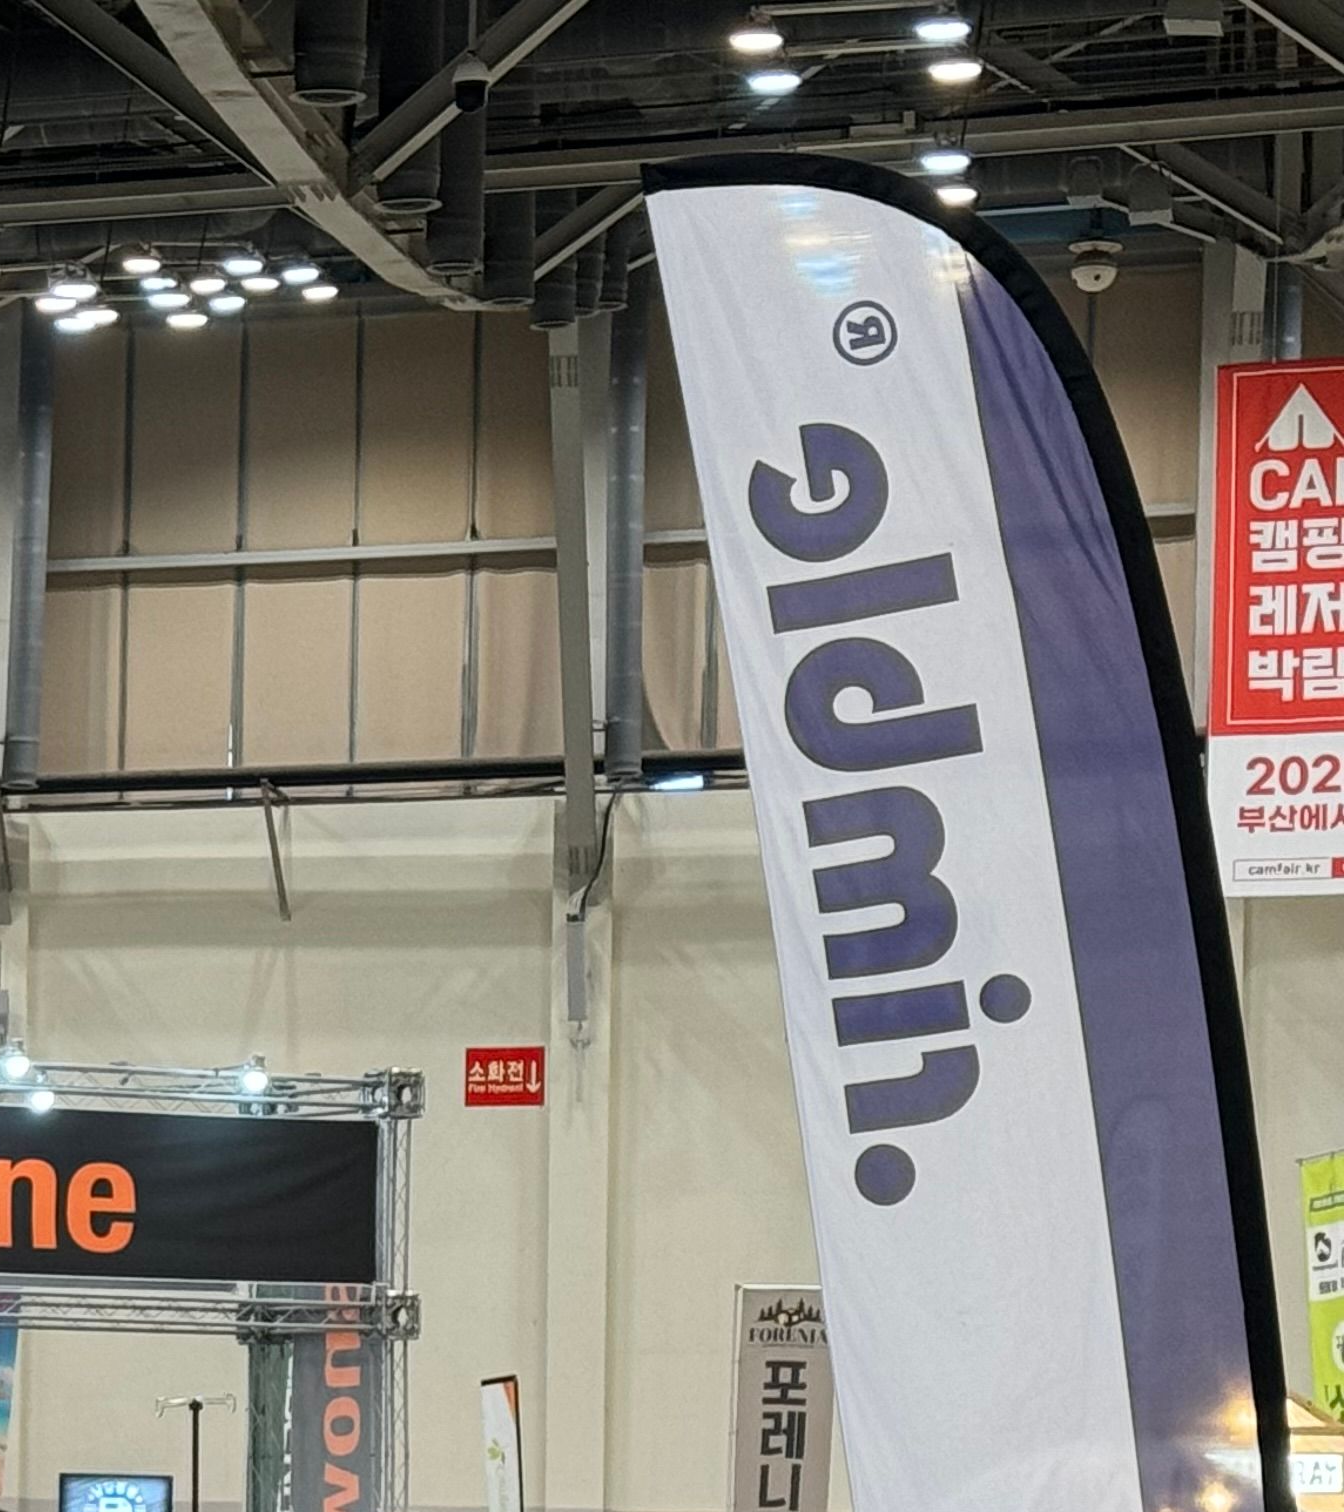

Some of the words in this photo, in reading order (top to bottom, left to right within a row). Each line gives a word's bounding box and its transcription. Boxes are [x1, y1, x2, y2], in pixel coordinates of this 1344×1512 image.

[1250, 517, 1344, 573] 캠핑
[1249, 582, 1344, 635] 레저
[1248, 647, 1344, 702] 박람
[468, 1059, 525, 1083] 소화전
